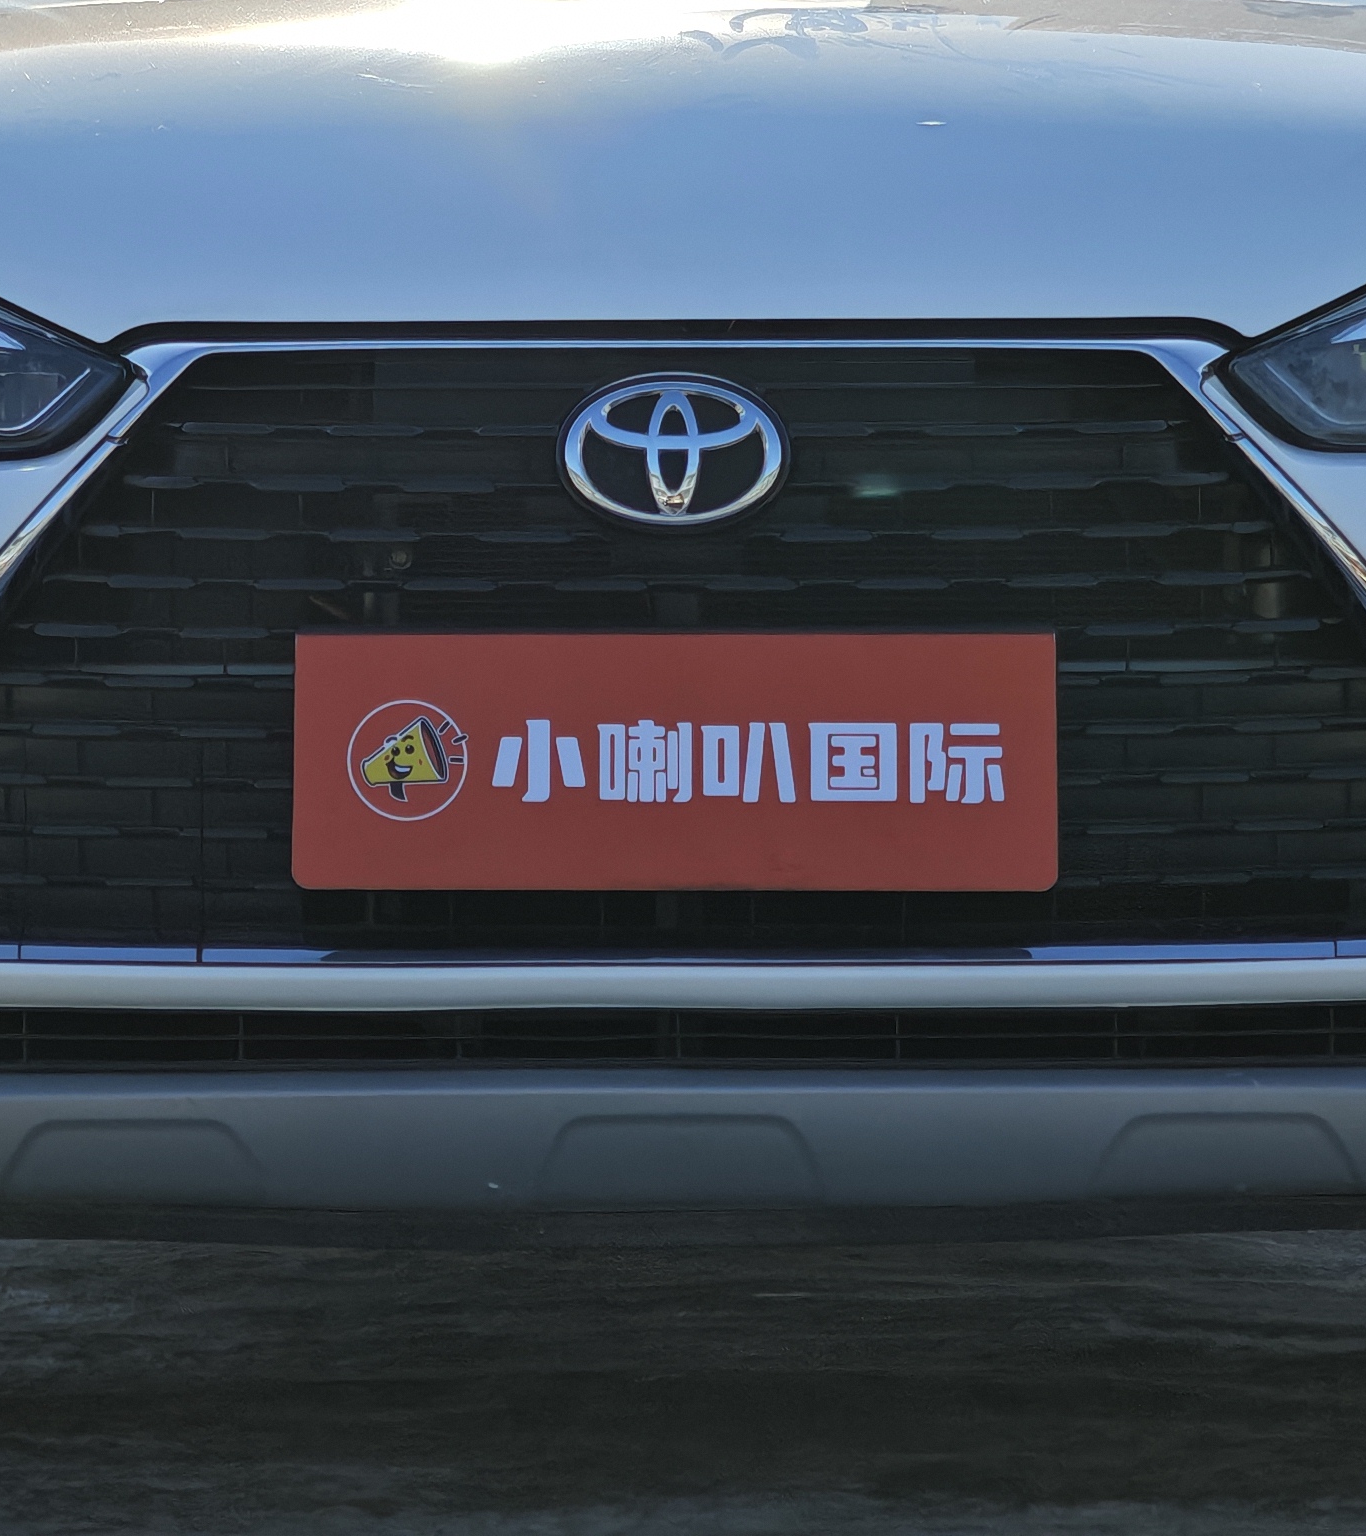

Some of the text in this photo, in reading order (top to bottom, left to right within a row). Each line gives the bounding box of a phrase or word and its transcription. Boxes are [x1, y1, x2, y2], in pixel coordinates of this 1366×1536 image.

[491, 719, 1005, 804] 小喇叭国际
